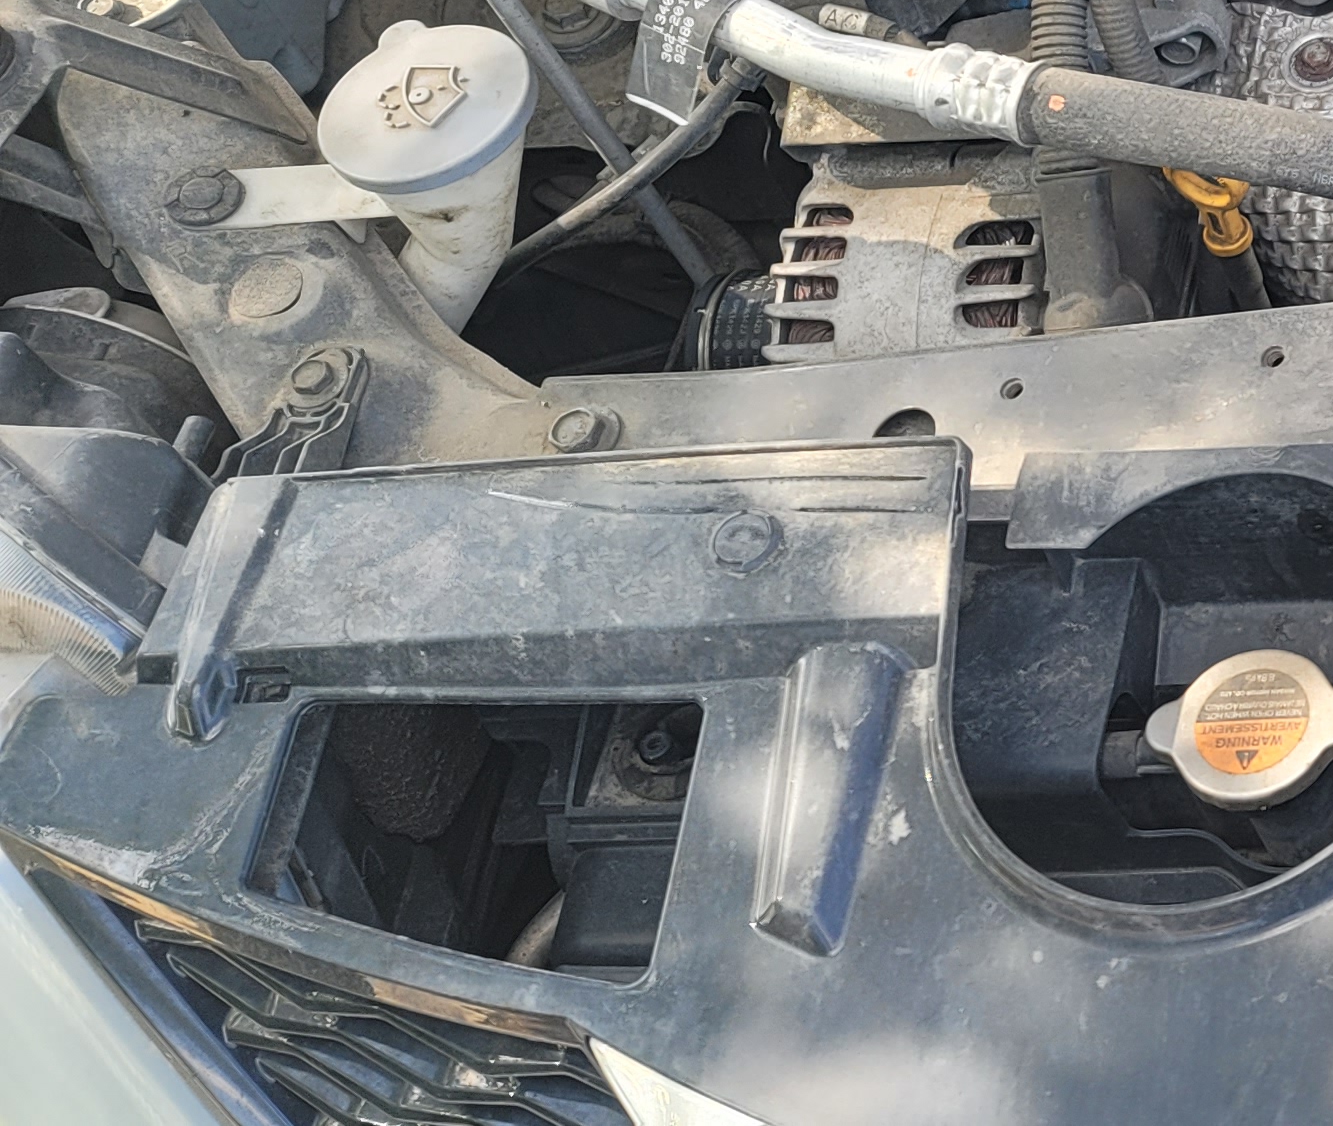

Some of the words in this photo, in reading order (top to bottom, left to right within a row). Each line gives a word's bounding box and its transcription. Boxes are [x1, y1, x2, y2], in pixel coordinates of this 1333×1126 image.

[1223, 710, 1251, 719] WHEN
[1251, 709, 1274, 718] OPEN
[1274, 708, 1303, 717] NEVER
[1202, 722, 1301, 735] AVERTISSEMENT
[1215, 734, 1284, 749] WARNING
